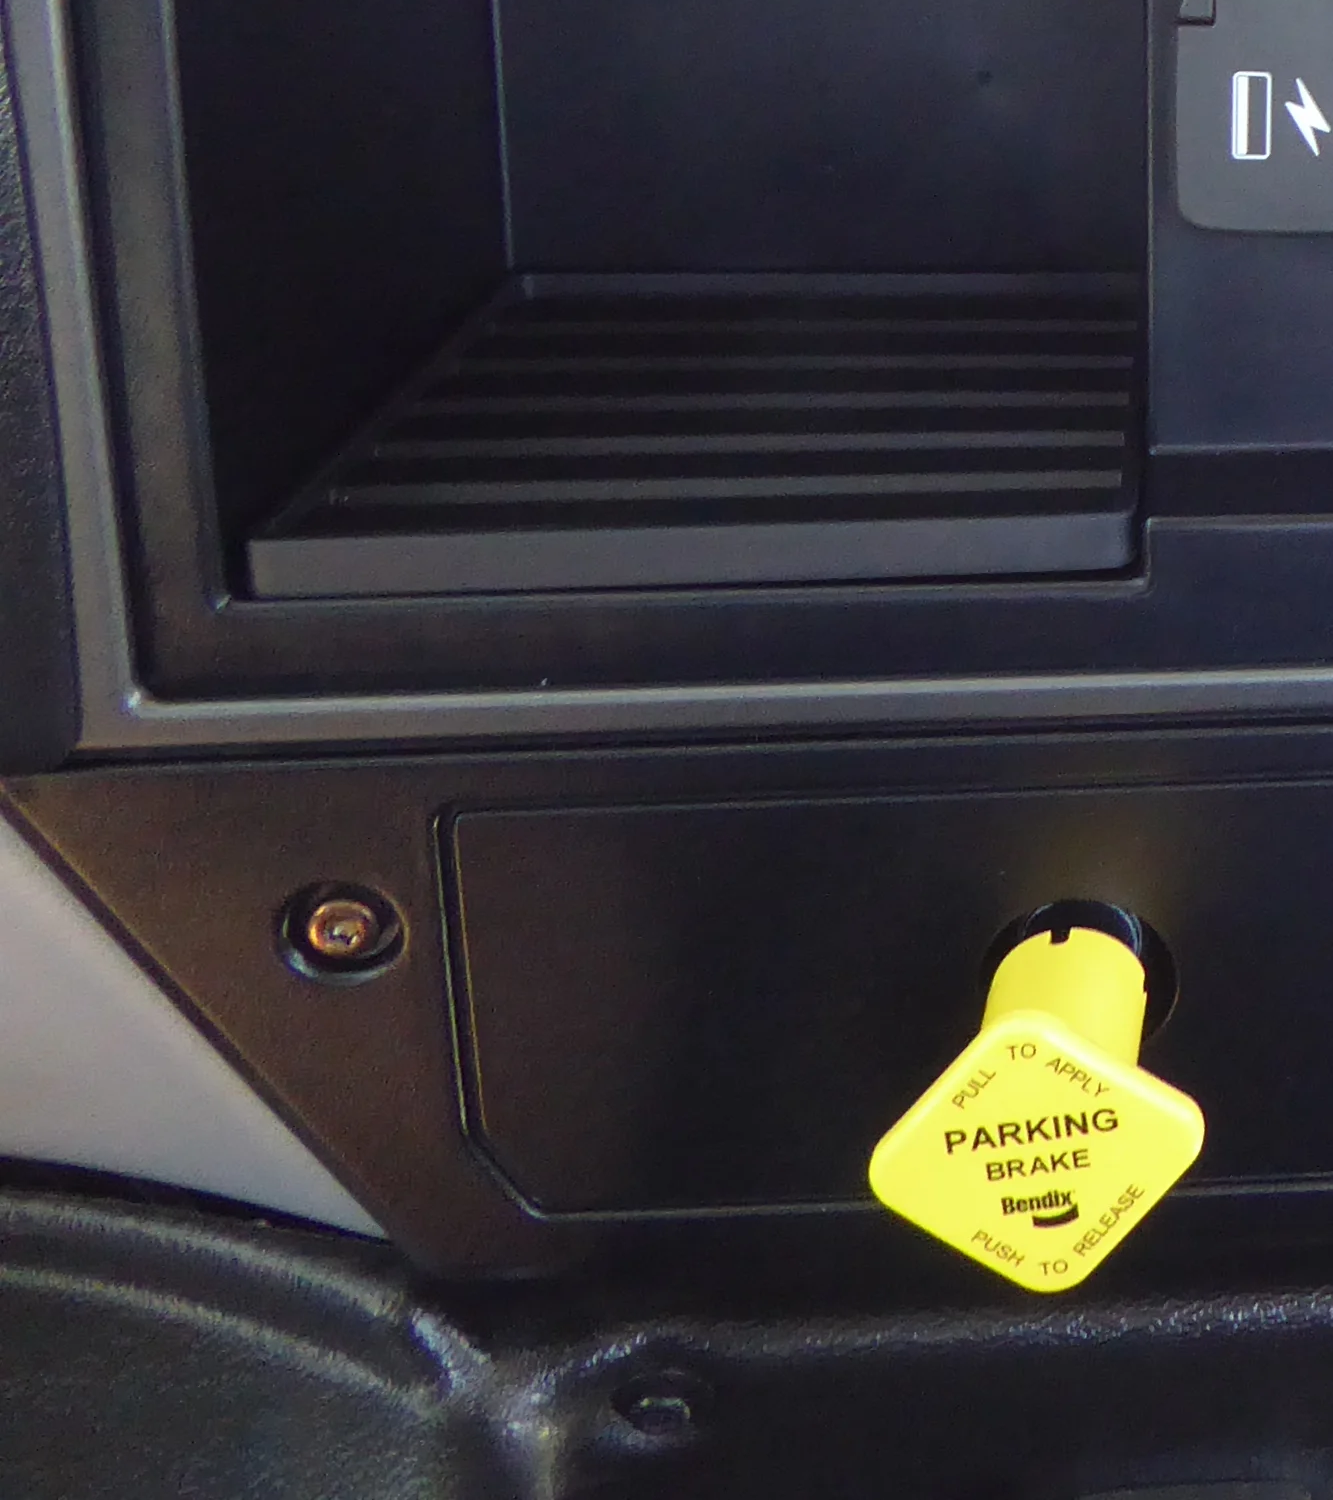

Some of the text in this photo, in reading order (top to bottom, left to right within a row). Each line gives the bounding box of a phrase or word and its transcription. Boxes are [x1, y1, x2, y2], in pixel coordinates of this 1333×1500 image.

[951, 1043, 1110, 1110] PULL TO APPLY
[944, 1108, 1119, 1155] PARKING
[986, 1148, 1091, 1182] BRAKE
[1000, 1189, 1073, 1216] Bendix
[970, 1183, 1145, 1277] PUSH TO RELEASE
